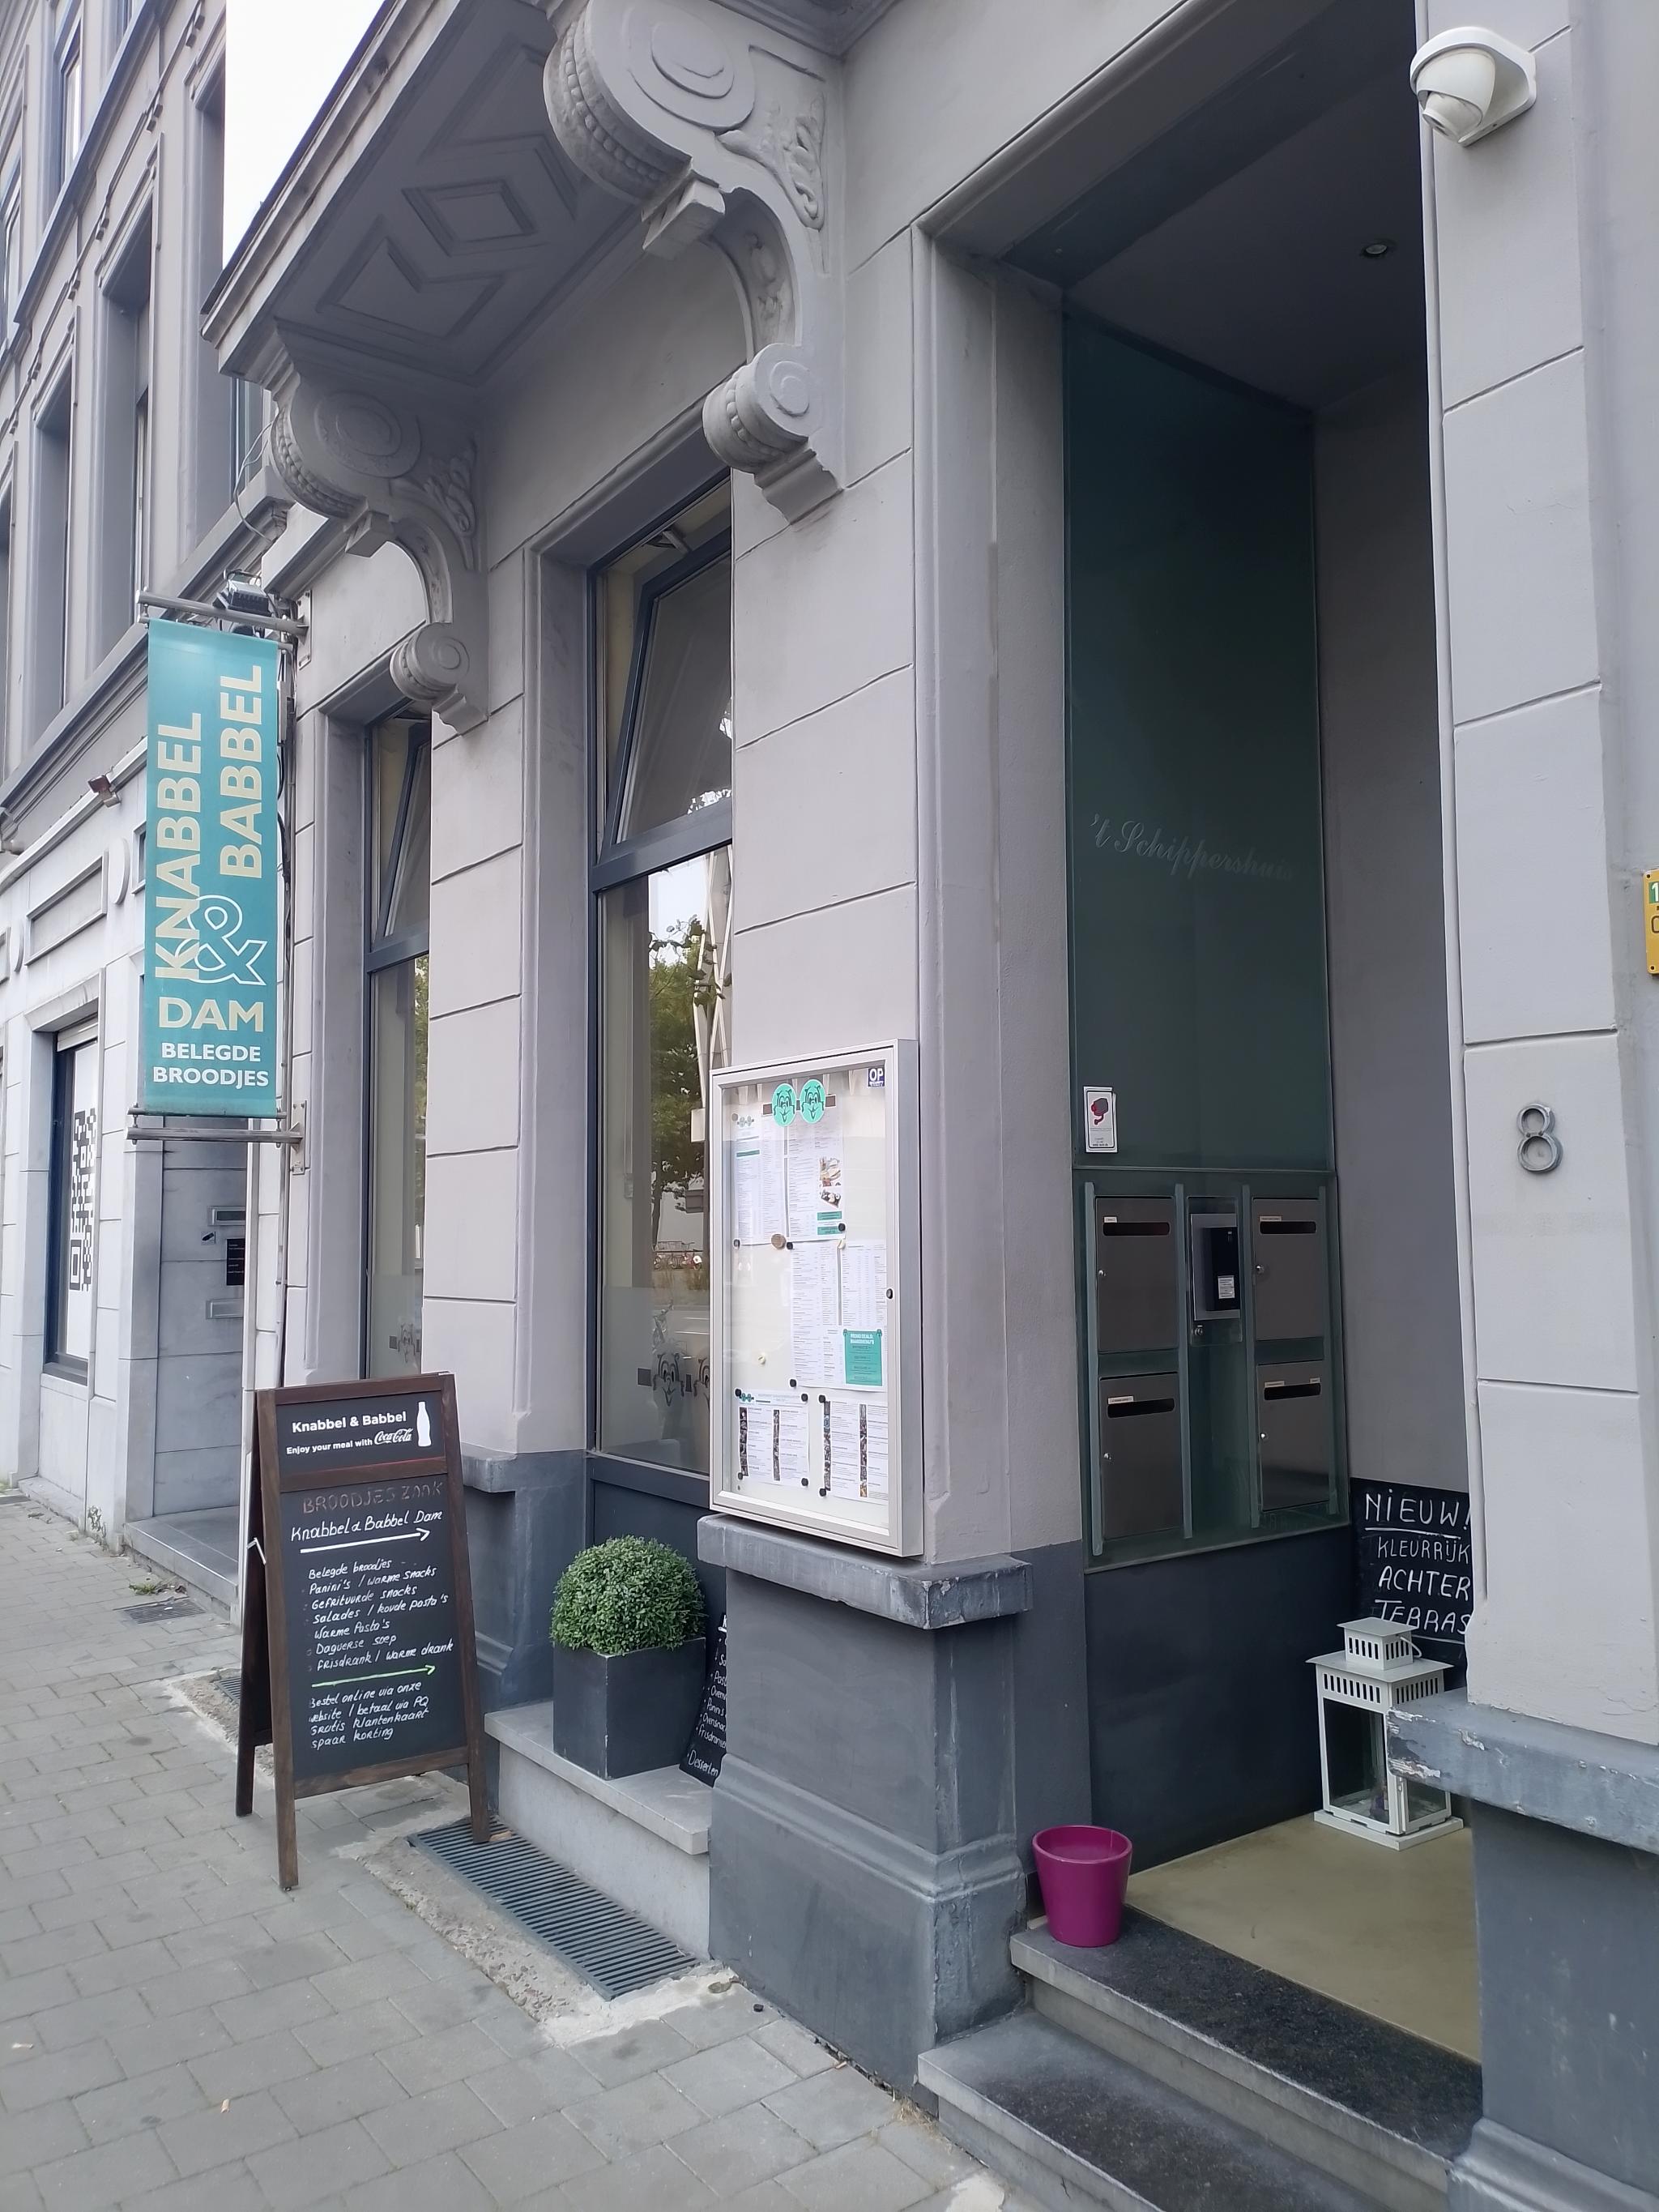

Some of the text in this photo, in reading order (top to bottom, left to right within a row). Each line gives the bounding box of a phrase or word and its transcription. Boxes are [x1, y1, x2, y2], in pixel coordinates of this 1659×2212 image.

[220, 664, 263, 879] BABBEL
[156, 713, 202, 981] KNABBEL
[158, 997, 264, 1032] DAM
[161, 1042, 262, 1064] BELEGDE
[152, 1066, 270, 1089] BROODJES
[1516, 1103, 1563, 1174] 8
[292, 1411, 407, 1433] Knabbel & Babbel
[286, 1445, 310, 1455] Enjoy
[312, 1442, 331, 1453] your
[333, 1441, 353, 1450] meal
[355, 1438, 373, 1448] with
[303, 1486, 396, 1514] BROODJES
[290, 1517, 350, 1542] Knabbel
[364, 1510, 410, 1532] Babbel
[413, 1510, 443, 1524] Dam
[308, 1557, 392, 1580] Belegde broodjes
[309, 1578, 351, 1595] Panini's
[403, 1565, 437, 1580] snacks
[1378, 1565, 1471, 1602] ACHTER
[380, 1584, 418, 1599] snacks
[377, 1600, 406, 1614] koude
[316, 1634, 397, 1656] Dagverse soep
[420, 1638, 454, 1655] drank
[342, 1689, 376, 1703] online
[378, 1685, 394, 1697] via
[396, 1681, 422, 1693] onze
[356, 1700, 392, 1715] betaal
[394, 1699, 408, 1710] via
[353, 1727, 394, 1742] korting
